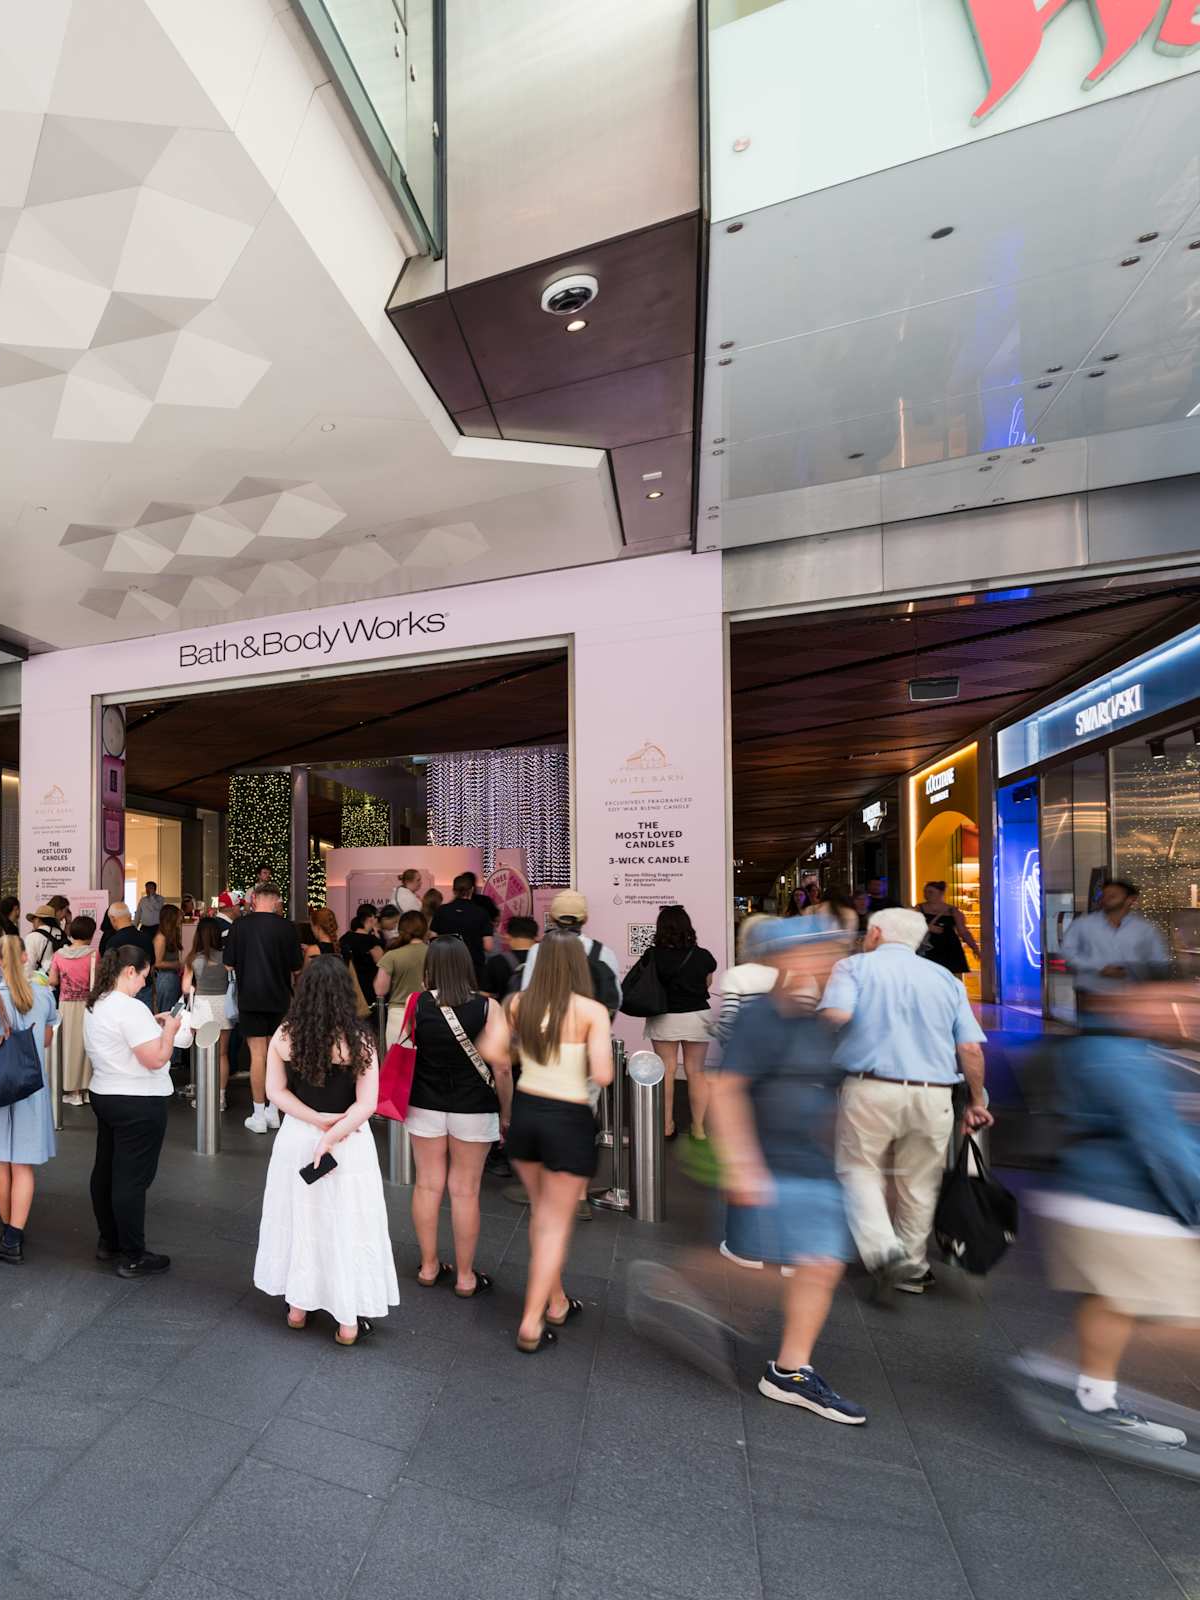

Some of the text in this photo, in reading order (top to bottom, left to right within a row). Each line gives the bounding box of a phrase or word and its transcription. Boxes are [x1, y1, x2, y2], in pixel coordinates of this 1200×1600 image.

[342, 611, 446, 644] Works
[637, 821, 659, 829] THE
[615, 830, 683, 839] MOST LOVED
[625, 840, 675, 849] CANDLES
[647, 856, 690, 864] CANDLE
